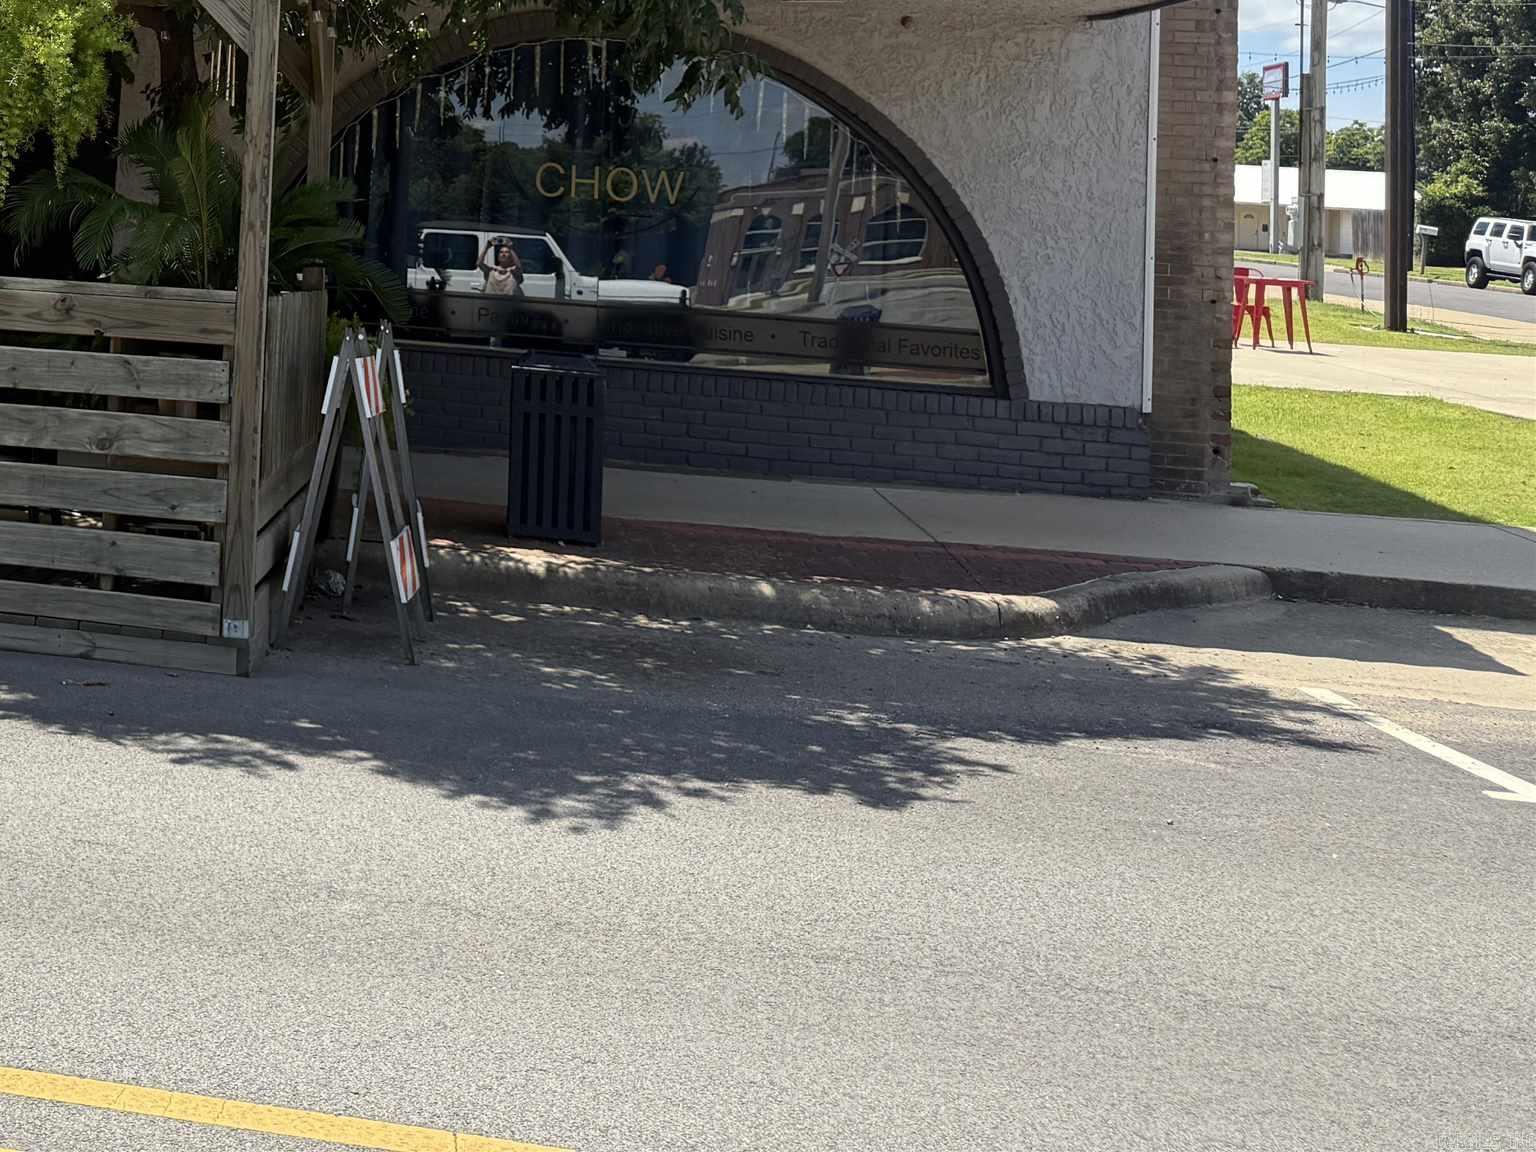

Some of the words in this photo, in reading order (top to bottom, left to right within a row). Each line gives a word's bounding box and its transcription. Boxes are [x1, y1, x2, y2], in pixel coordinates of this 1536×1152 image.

[535, 161, 685, 205] CHOW
[701, 325, 755, 344] uisine
[798, 329, 891, 353] Tradal
[897, 338, 982, 361] Favorites
